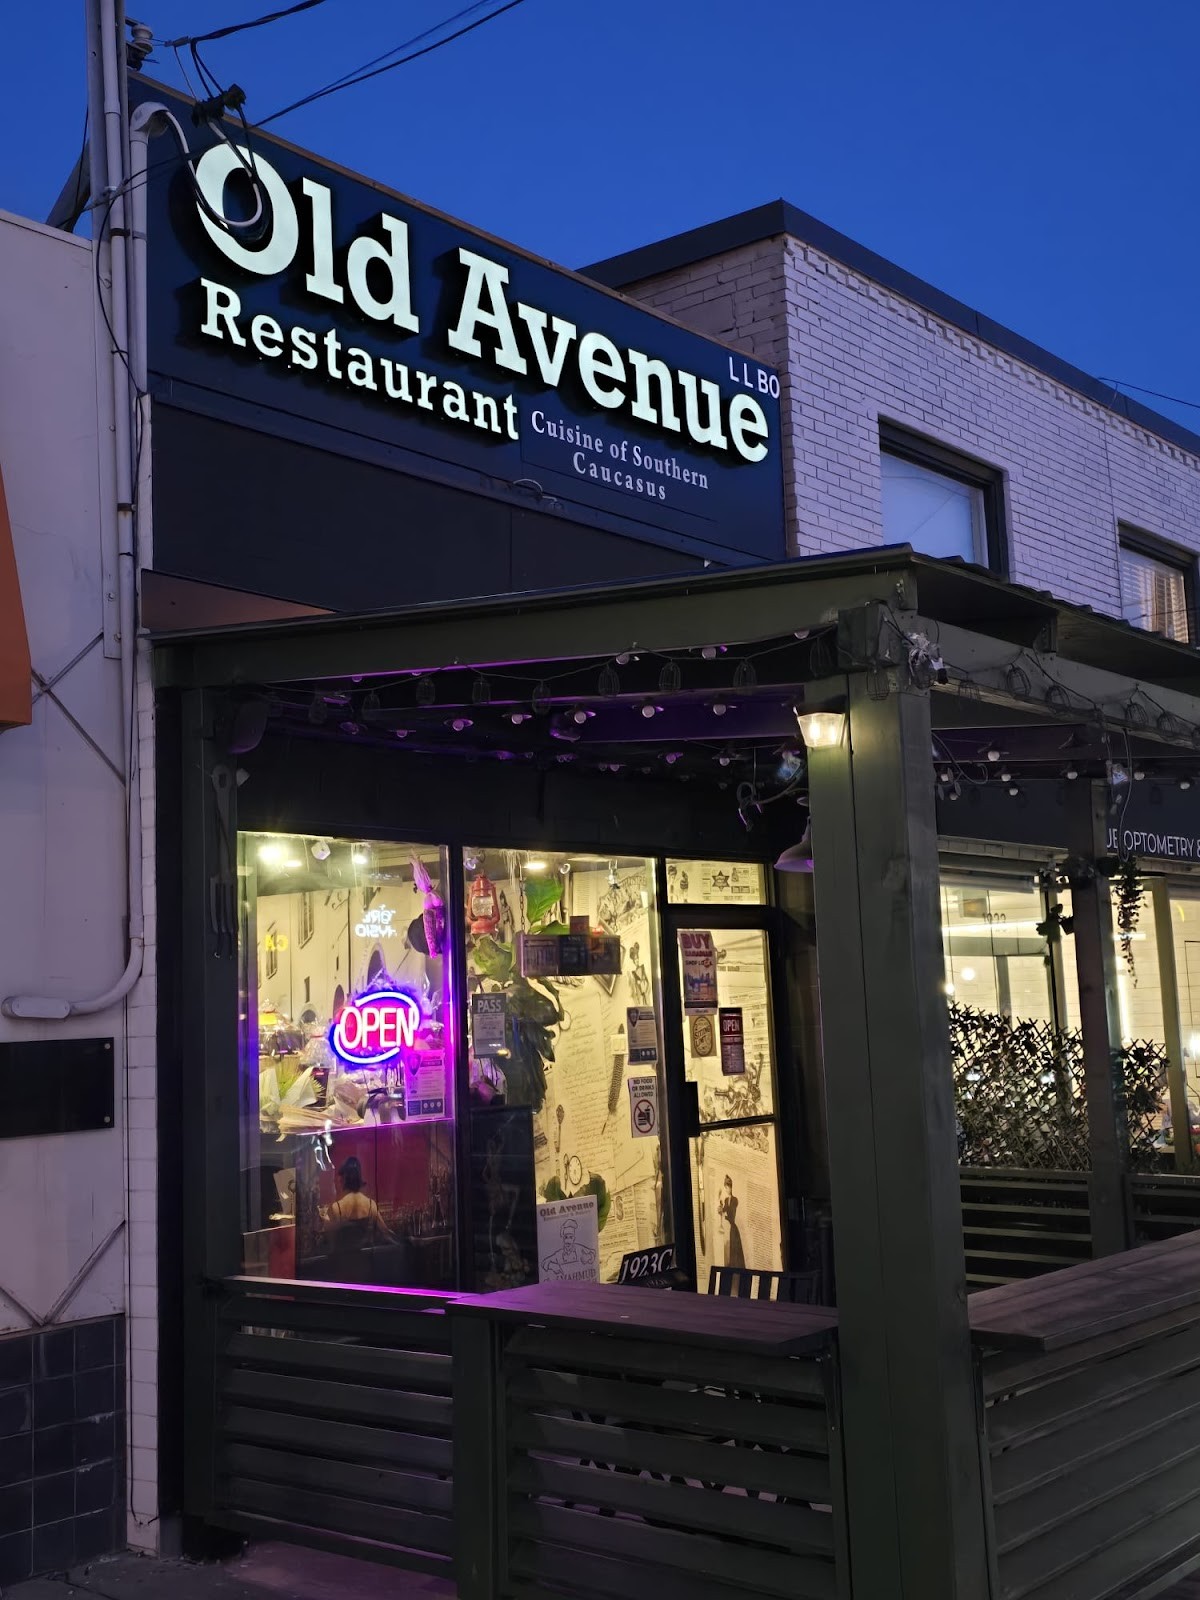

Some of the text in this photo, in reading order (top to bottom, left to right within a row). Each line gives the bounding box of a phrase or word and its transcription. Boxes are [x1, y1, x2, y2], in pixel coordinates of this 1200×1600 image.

[195, 143, 769, 463] Old Avenue
[200, 276, 519, 441] Restaurant
[531, 410, 709, 490] Cuisine of Southern
[572, 451, 666, 500] Caucasus
[1123, 830, 1195, 857] OPTOMETRY
[339, 1006, 414, 1049] OPEN
[477, 999, 502, 1013] PASS
[722, 1019, 740, 1032] OPEN
[539, 1206, 556, 1217] Old
[559, 1200, 594, 1214] Avenue
